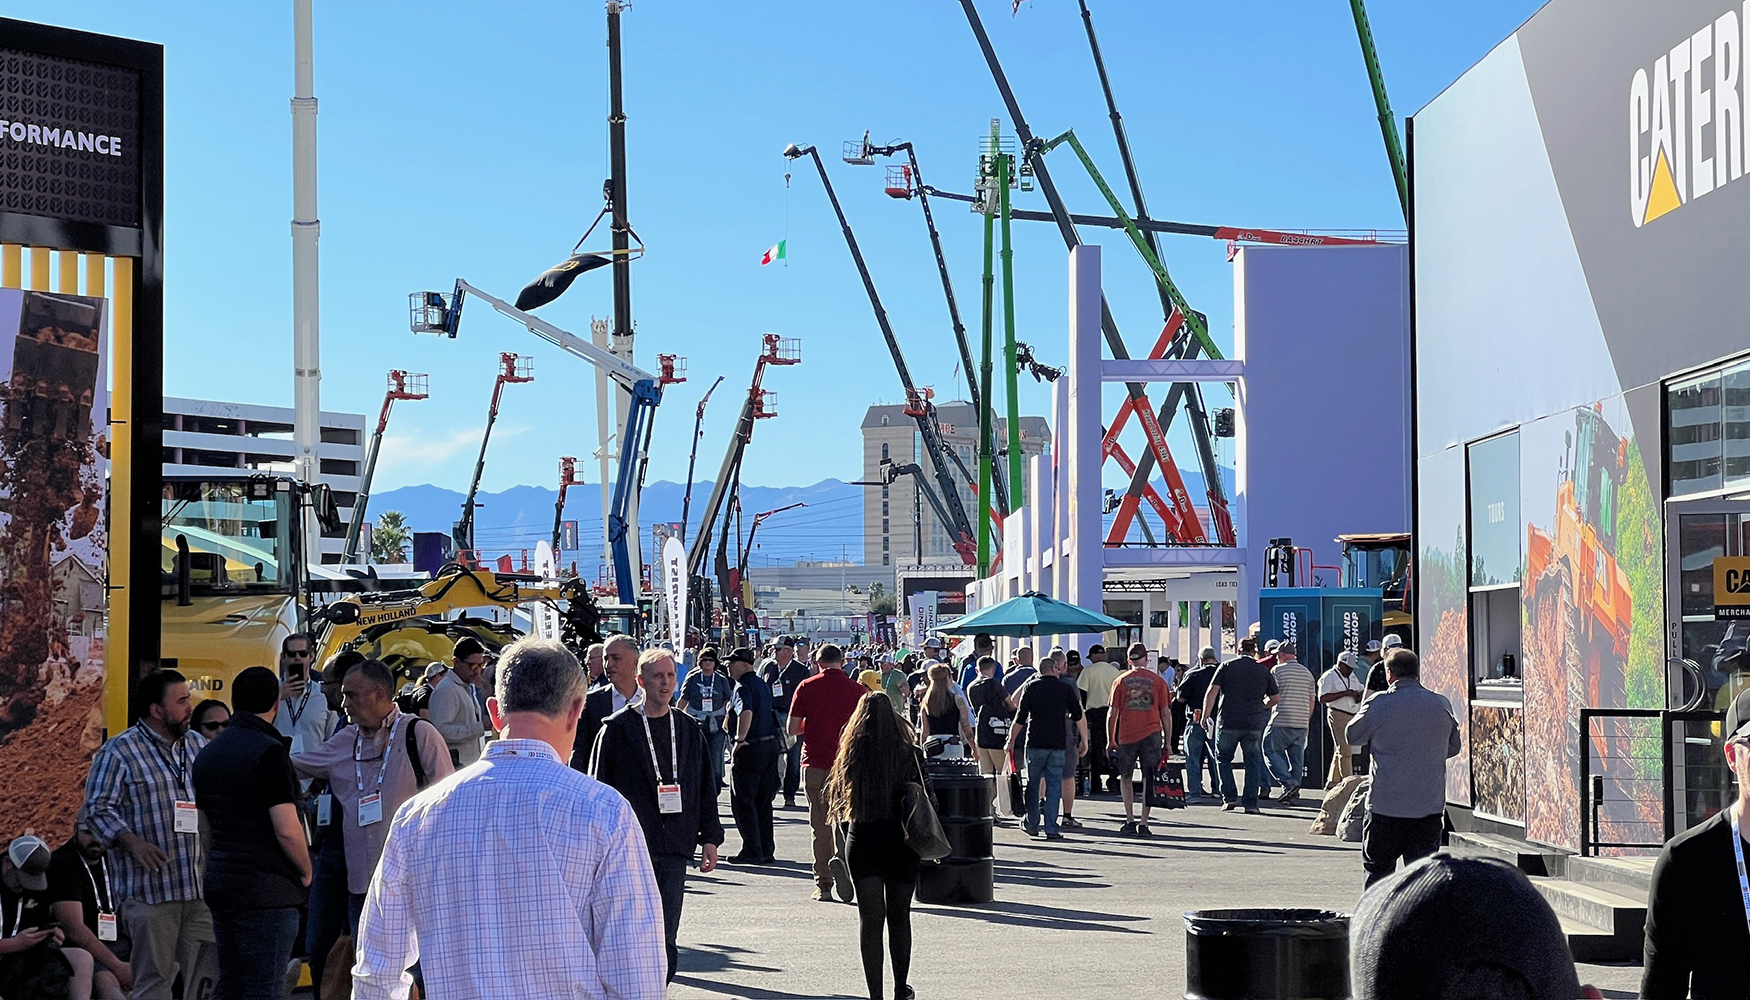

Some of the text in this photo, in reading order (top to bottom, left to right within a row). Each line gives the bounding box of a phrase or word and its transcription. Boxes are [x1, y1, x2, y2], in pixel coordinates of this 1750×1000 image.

[0, 120, 122, 156] FORMANCE
[356, 607, 417, 626] NEW HOLLAND
[189, 679, 223, 691] AND
